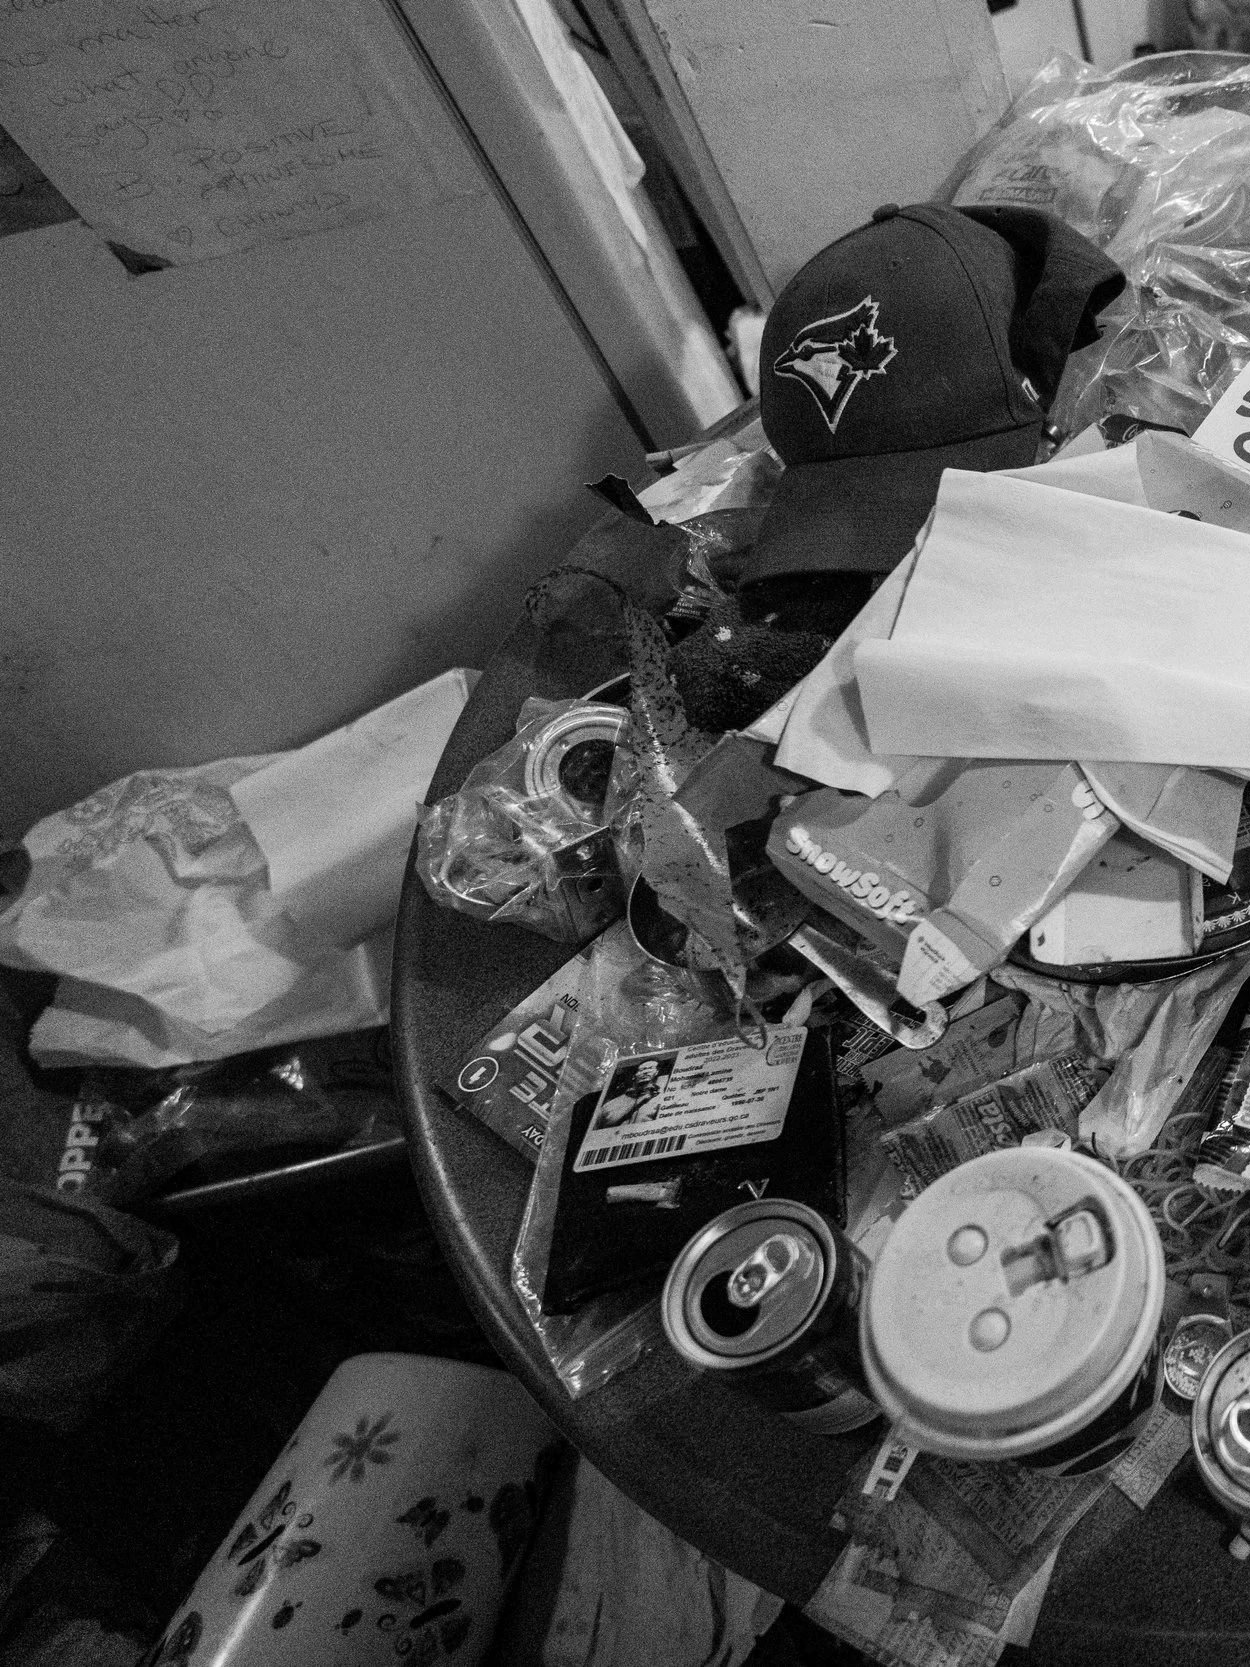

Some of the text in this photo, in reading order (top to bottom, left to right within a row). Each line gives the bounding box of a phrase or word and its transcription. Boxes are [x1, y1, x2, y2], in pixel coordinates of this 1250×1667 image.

[77, 5, 213, 53] matter
[49, 38, 290, 107] what anyone
[785, 825, 919, 925] SnowSoft
[658, 1110, 674, 1118] Date
[683, 1104, 716, 1114] naissance
[709, 1086, 727, 1094] dame
